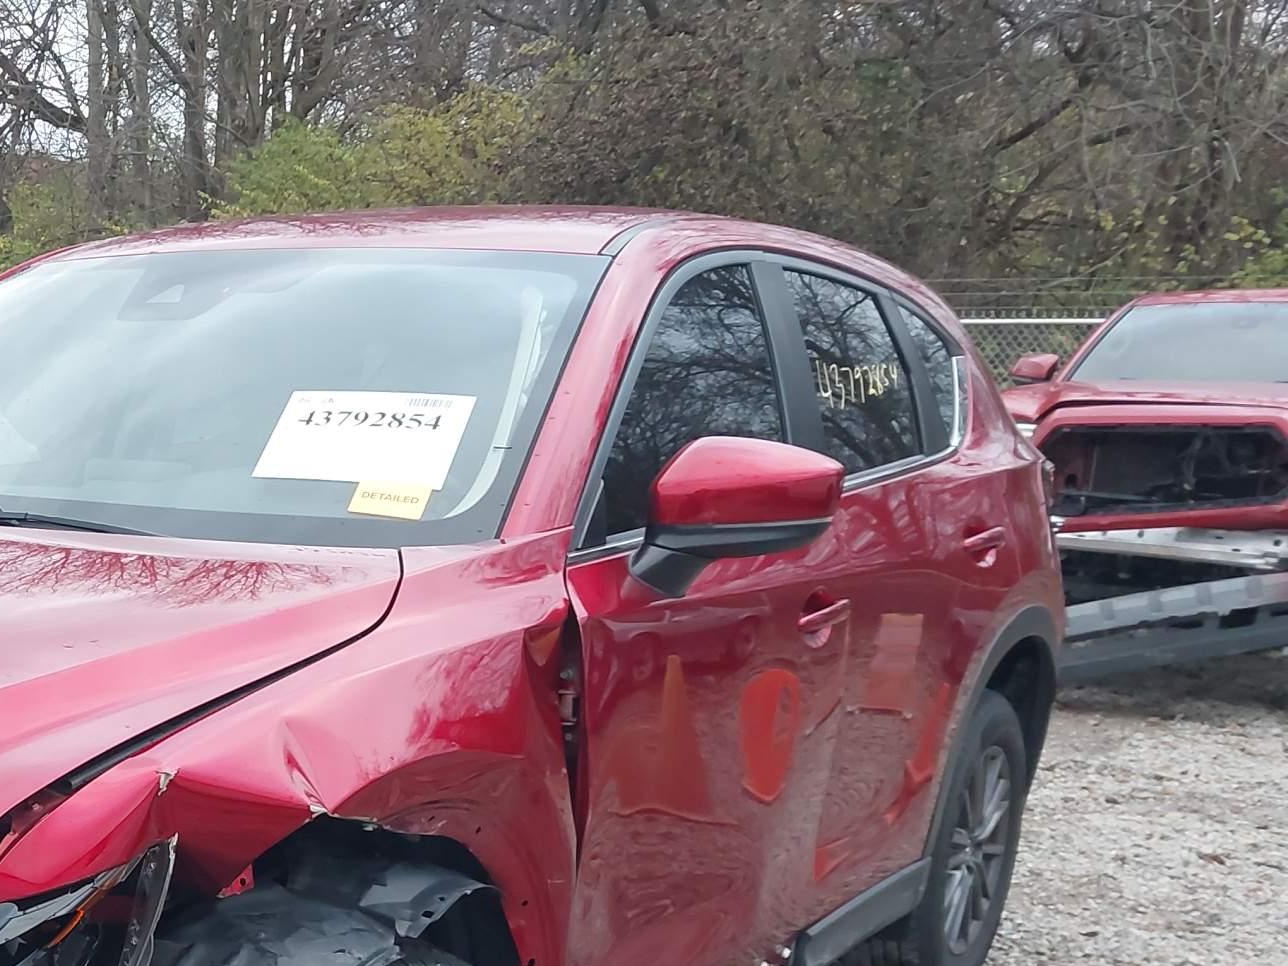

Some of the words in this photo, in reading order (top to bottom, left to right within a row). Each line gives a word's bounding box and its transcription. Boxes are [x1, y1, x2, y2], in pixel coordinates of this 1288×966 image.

[816, 360, 898, 409] 43792854
[299, 410, 442, 430] 43792854
[361, 491, 419, 504] DETAILED
